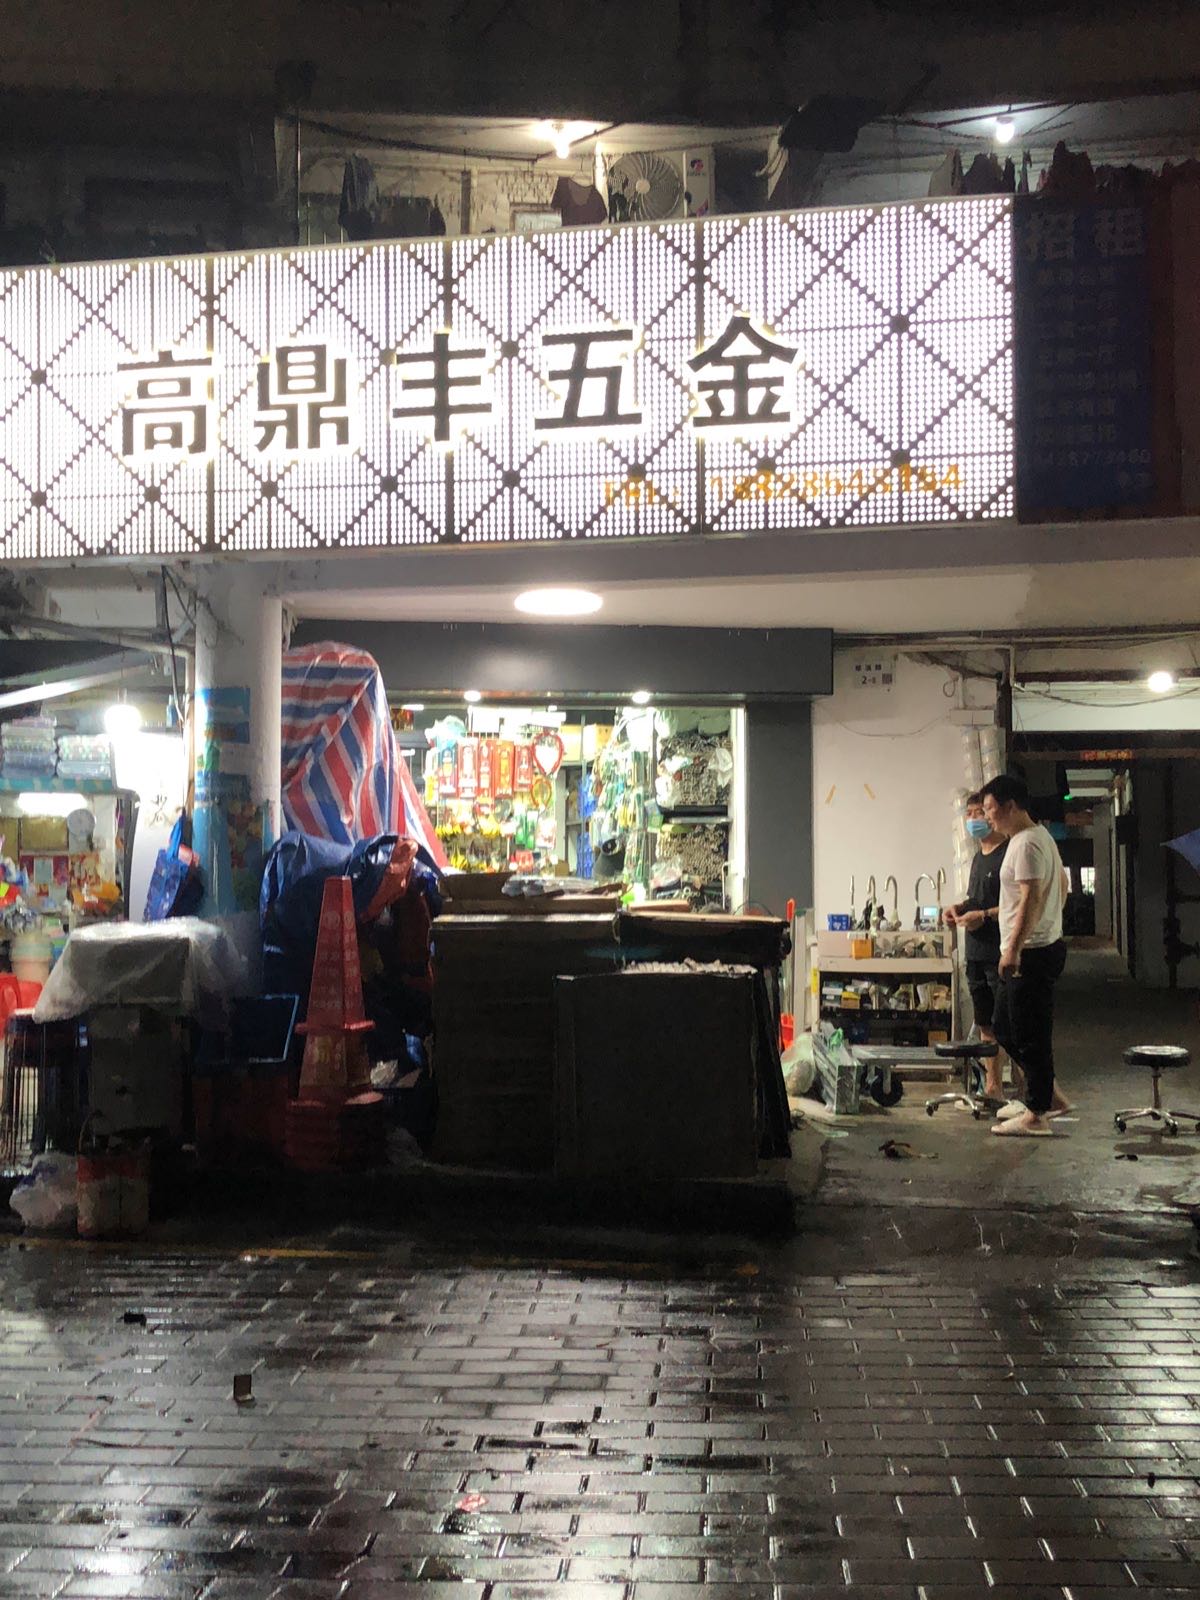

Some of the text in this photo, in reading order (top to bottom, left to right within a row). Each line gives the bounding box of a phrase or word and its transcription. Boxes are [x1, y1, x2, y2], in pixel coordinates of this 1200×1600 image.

[117, 317, 798, 455] 高鼎丰五金
